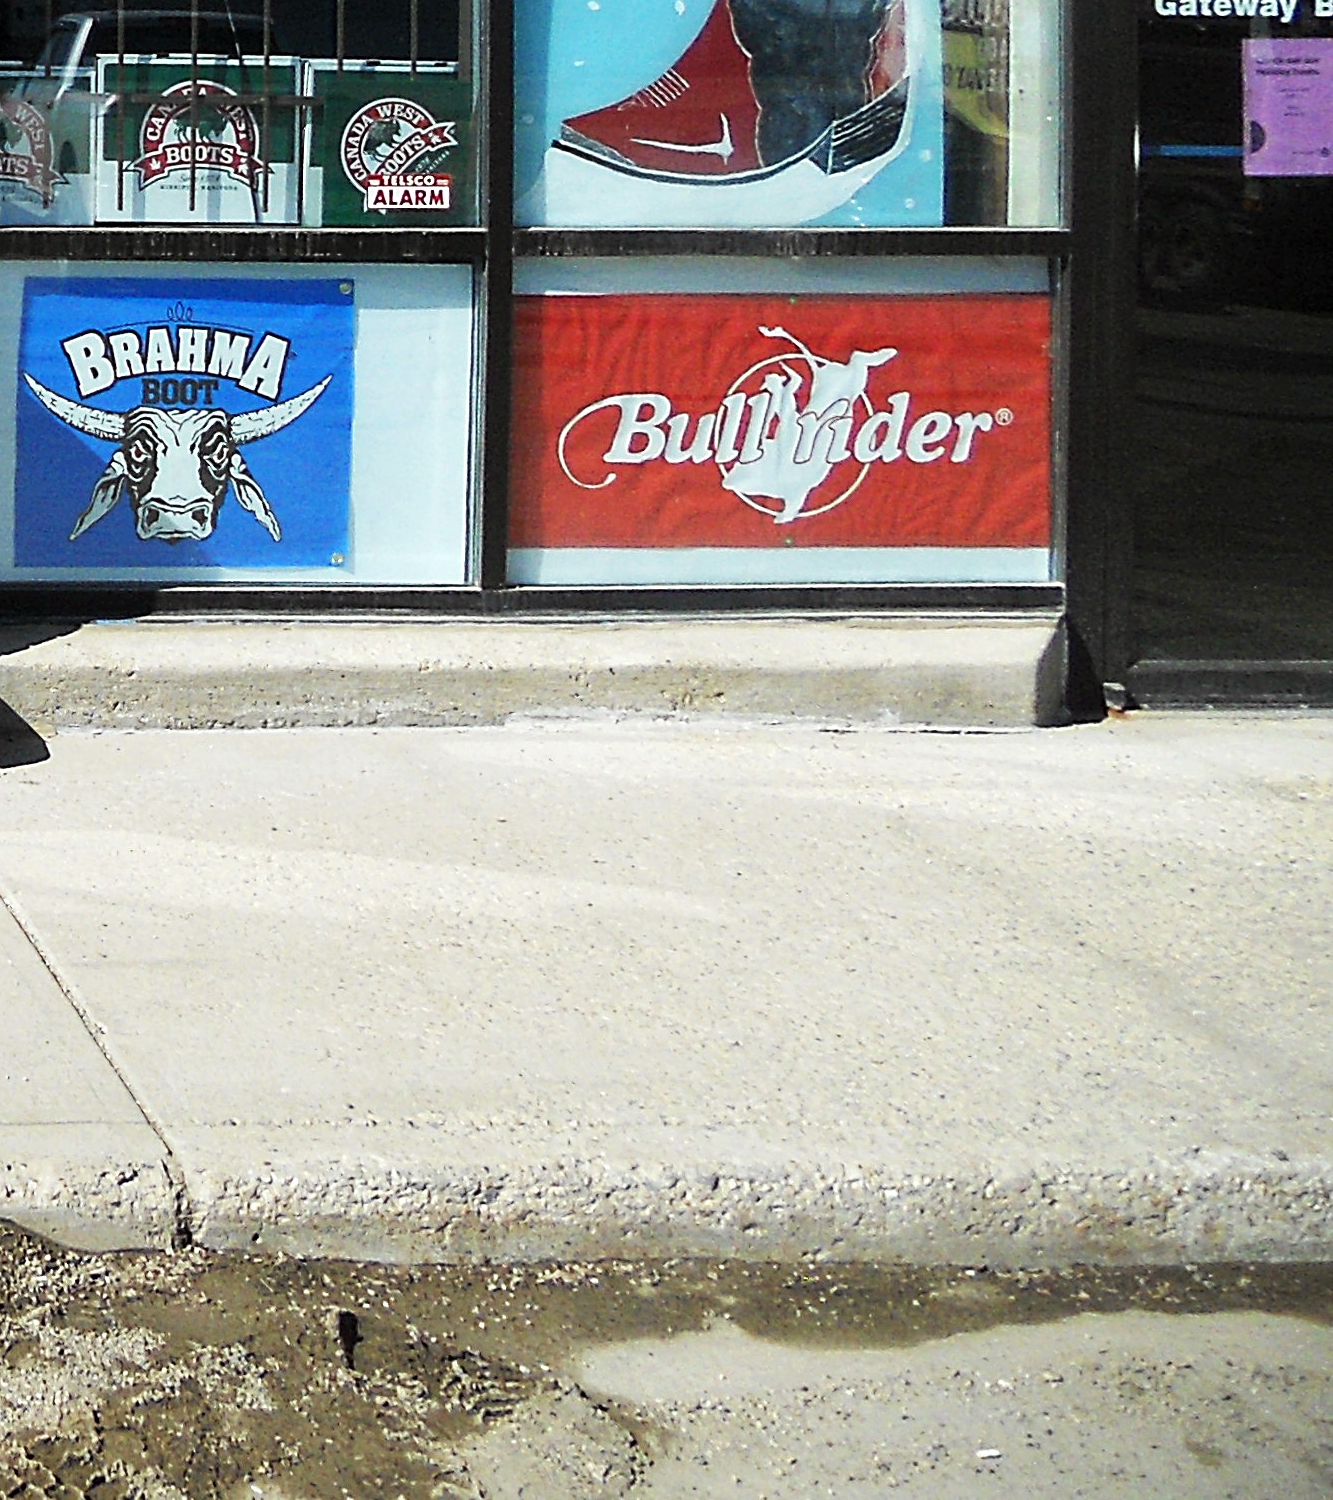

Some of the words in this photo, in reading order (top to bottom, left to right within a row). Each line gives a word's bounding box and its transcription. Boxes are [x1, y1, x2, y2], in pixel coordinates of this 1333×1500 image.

[346, 113, 374, 181] CANADA
[375, 103, 425, 125] WEST
[164, 145, 234, 164] BOOTS
[381, 175, 436, 186] TELSCO
[372, 189, 445, 206] ALARM
[61, 325, 290, 400] BRAHMA
[141, 377, 220, 406] BOOT
